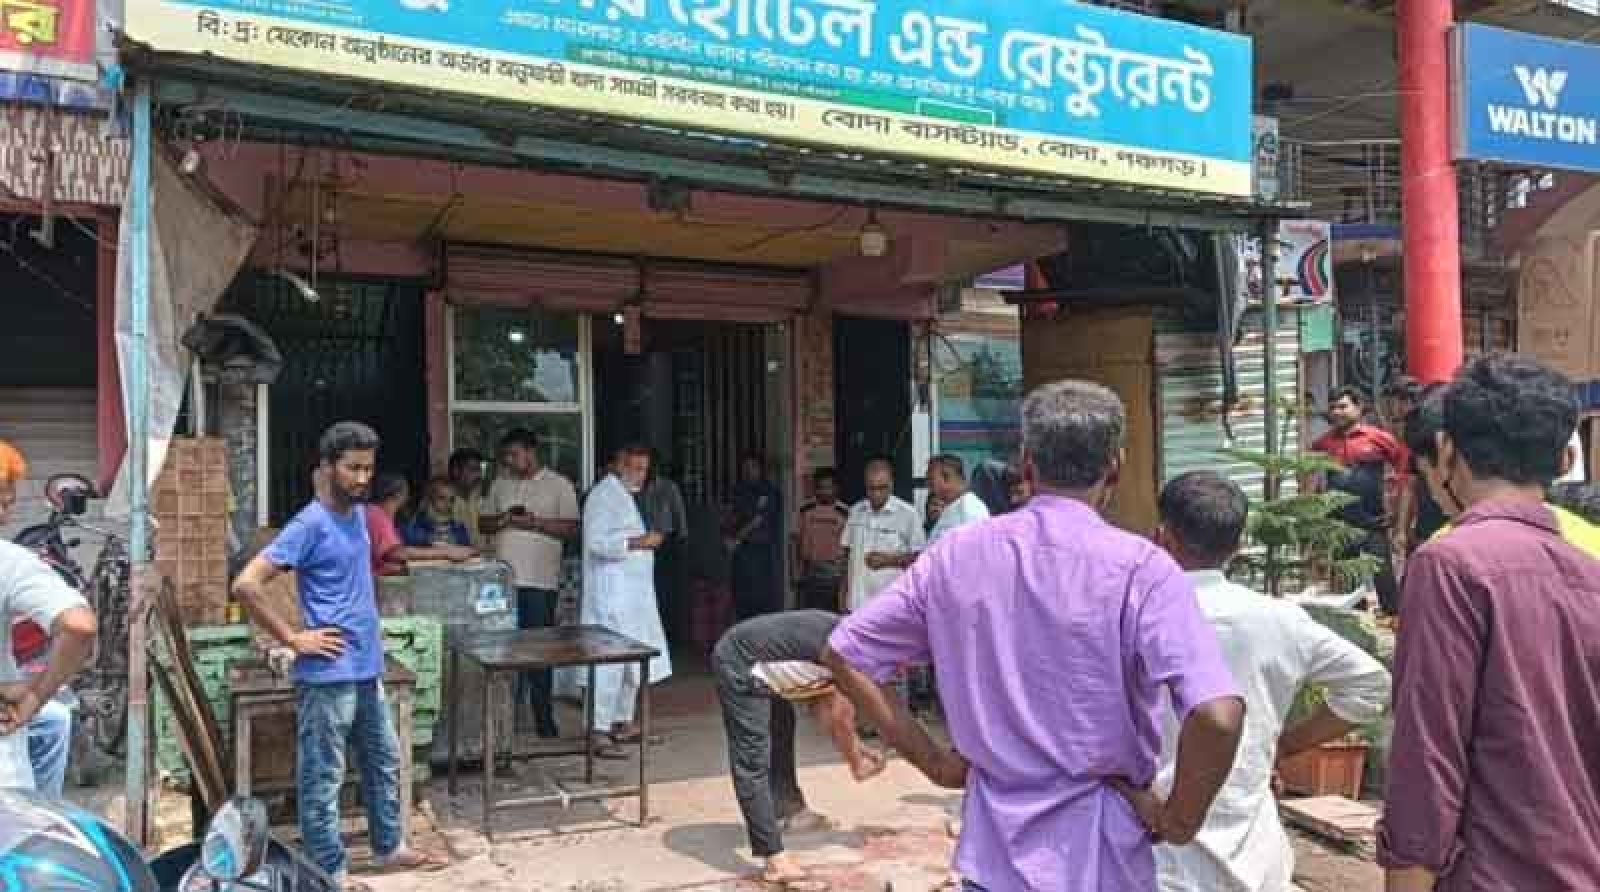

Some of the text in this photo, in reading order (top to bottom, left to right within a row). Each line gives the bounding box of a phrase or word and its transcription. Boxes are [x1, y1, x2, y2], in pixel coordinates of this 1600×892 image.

[889, 11, 987, 77] এন্ড
[1001, 24, 1214, 117] রেষ্টুরেন্ট
[821, 109, 891, 136] বোদা
[1487, 104, 1597, 144] WALTON
